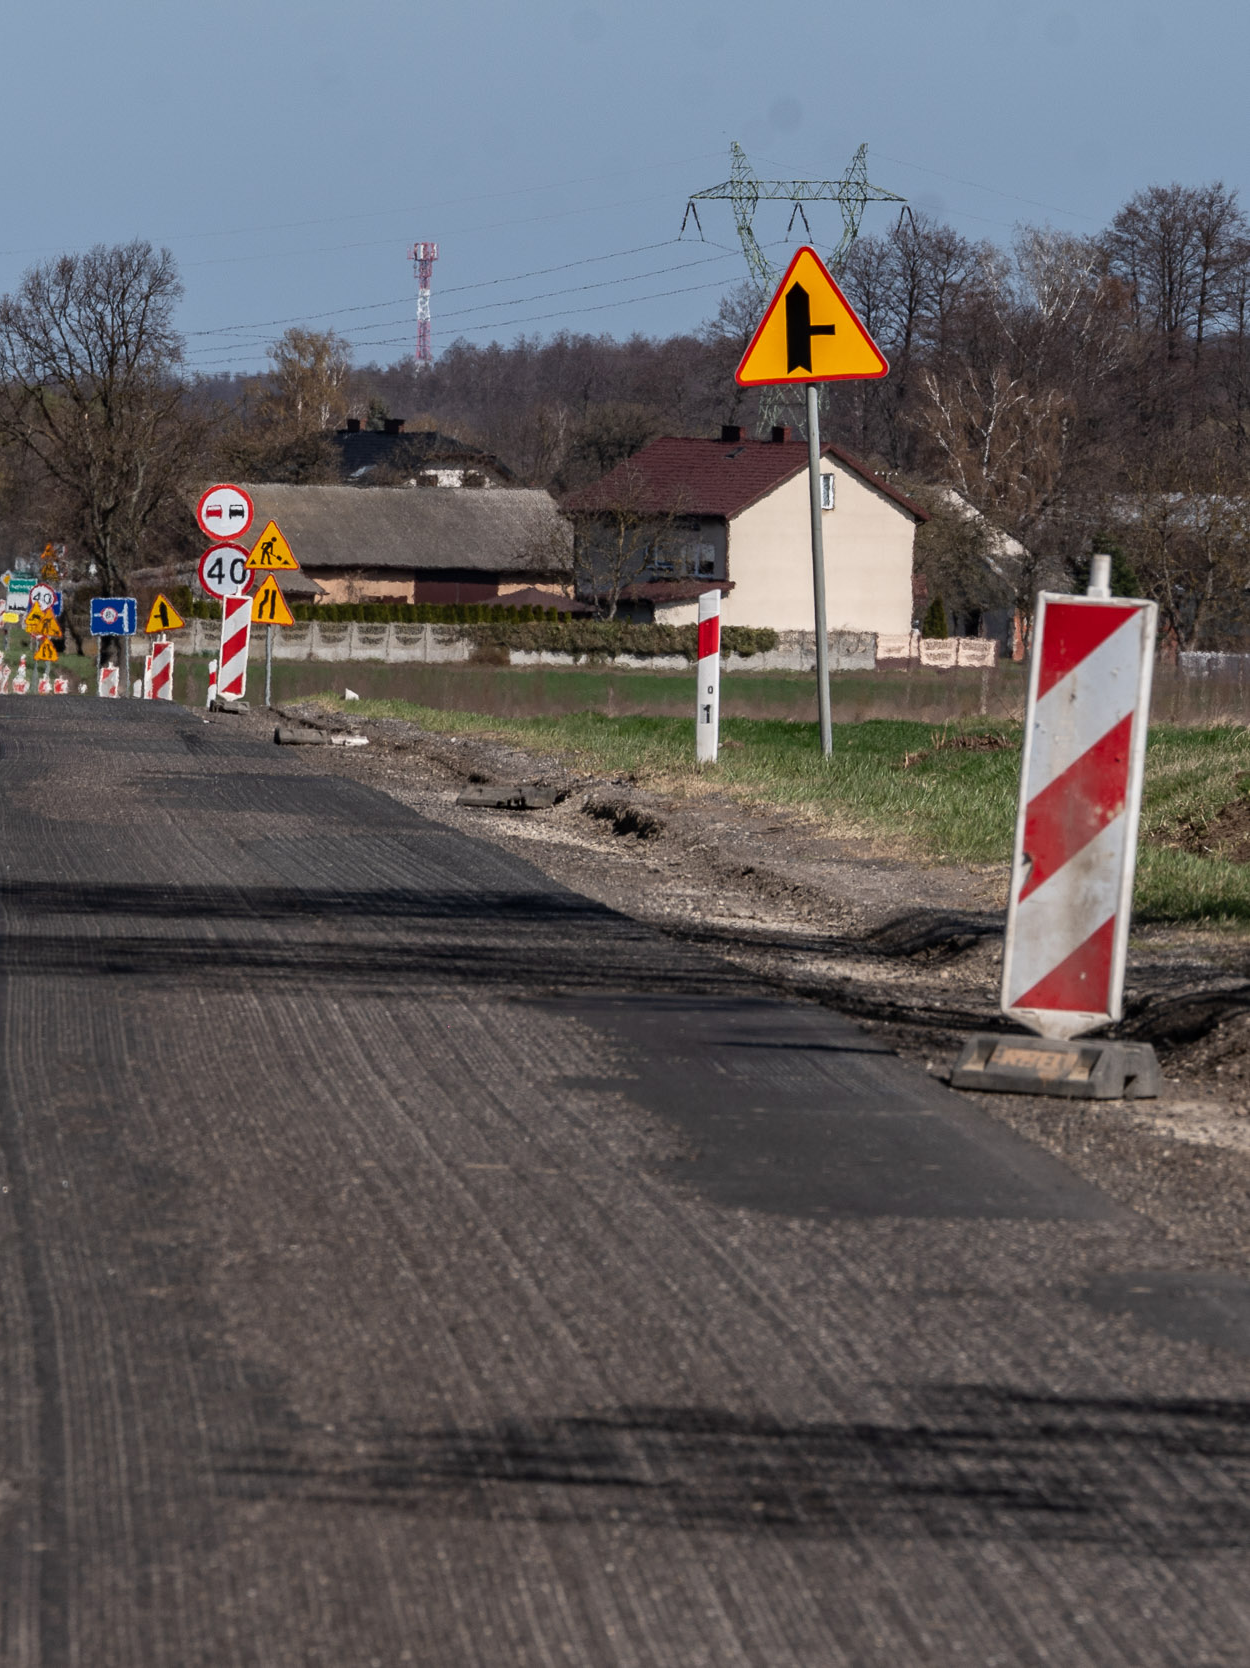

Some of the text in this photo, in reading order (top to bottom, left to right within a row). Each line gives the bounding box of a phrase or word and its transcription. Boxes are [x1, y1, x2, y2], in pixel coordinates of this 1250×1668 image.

[207, 557, 247, 584] 40
[33, 592, 51, 605] 40
[703, 704, 711, 724] 1
